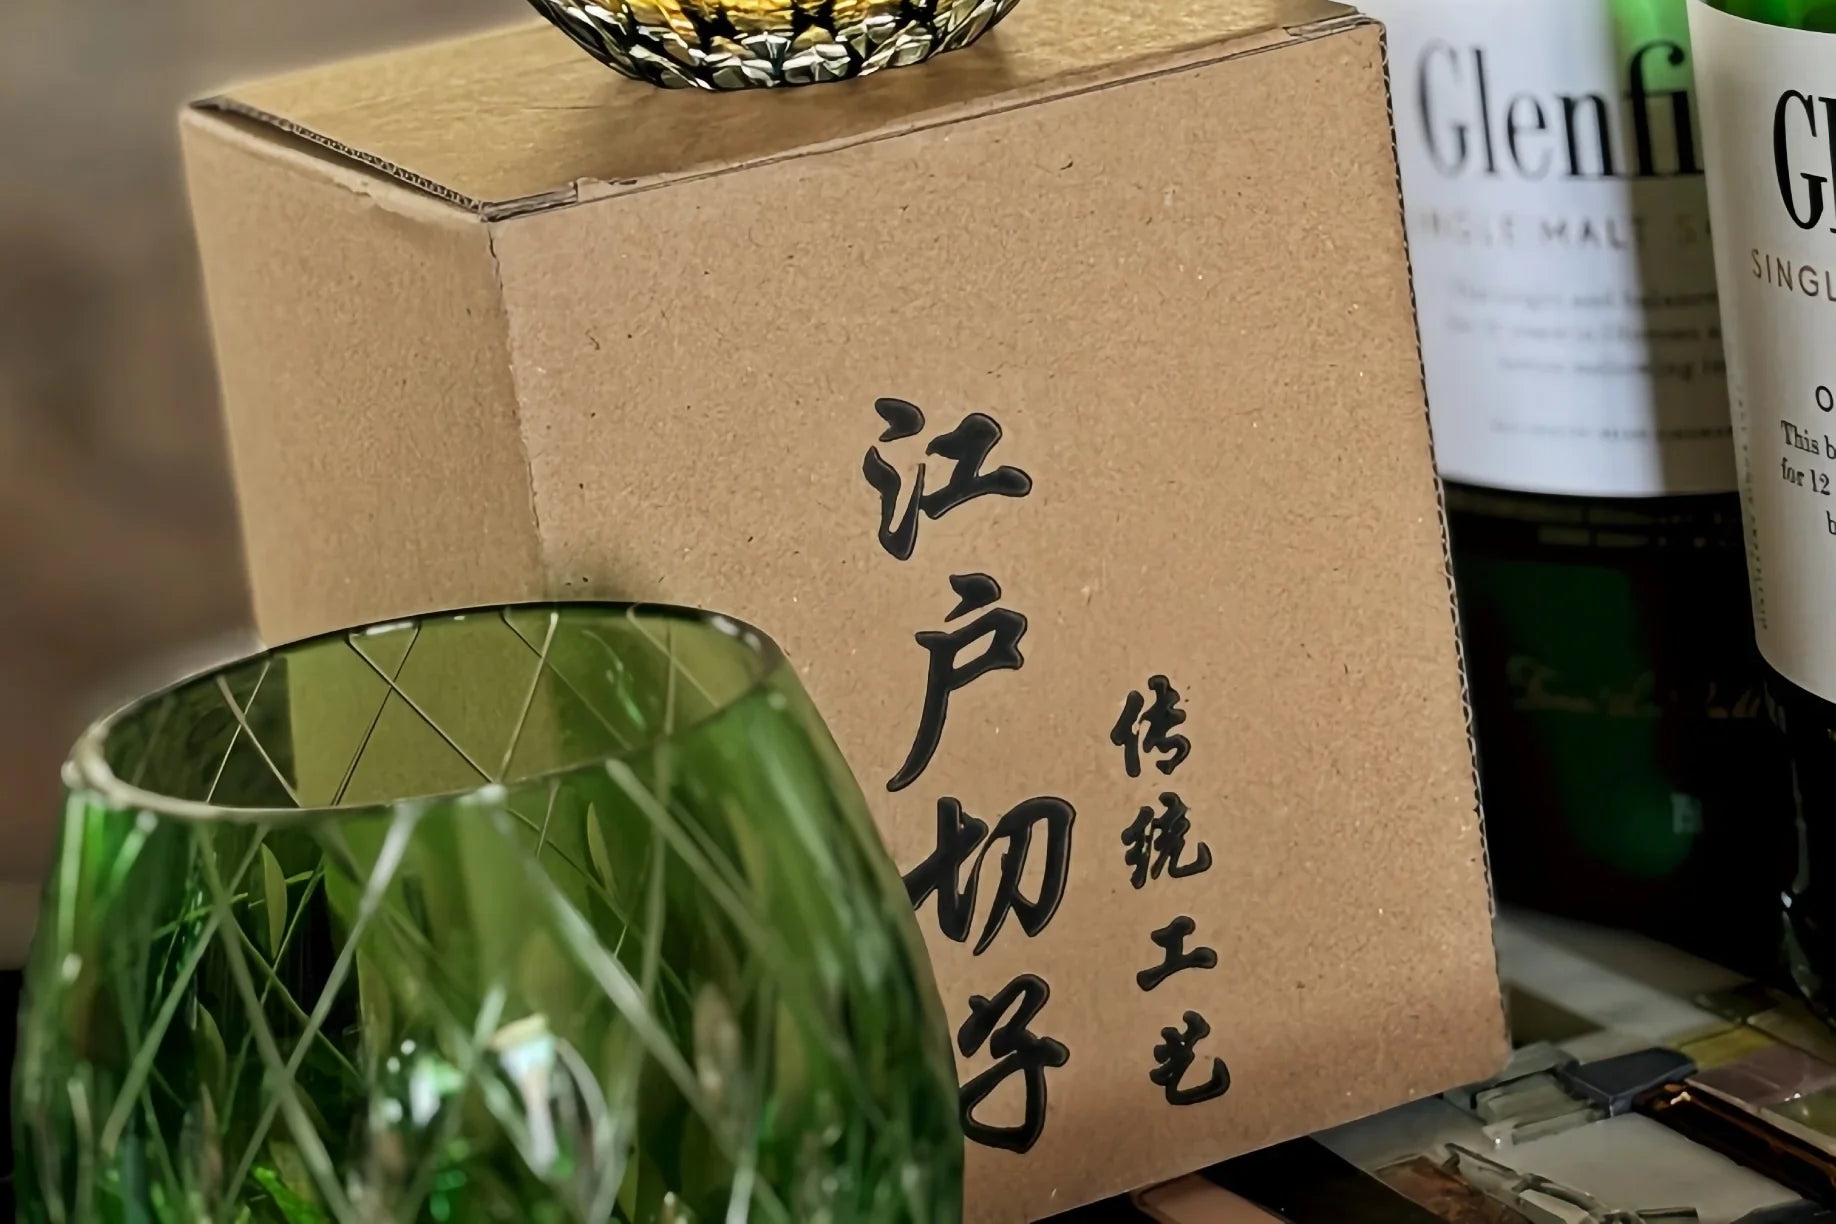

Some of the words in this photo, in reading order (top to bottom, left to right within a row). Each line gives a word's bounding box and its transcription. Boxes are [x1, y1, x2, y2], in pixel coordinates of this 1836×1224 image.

[1781, 420, 1820, 455] This
[1781, 457, 1805, 487] for
[1810, 469, 1831, 496] 12
[863, 397, 1077, 1153] 江户切子
[1110, 674, 1230, 1107] 传统工艺
